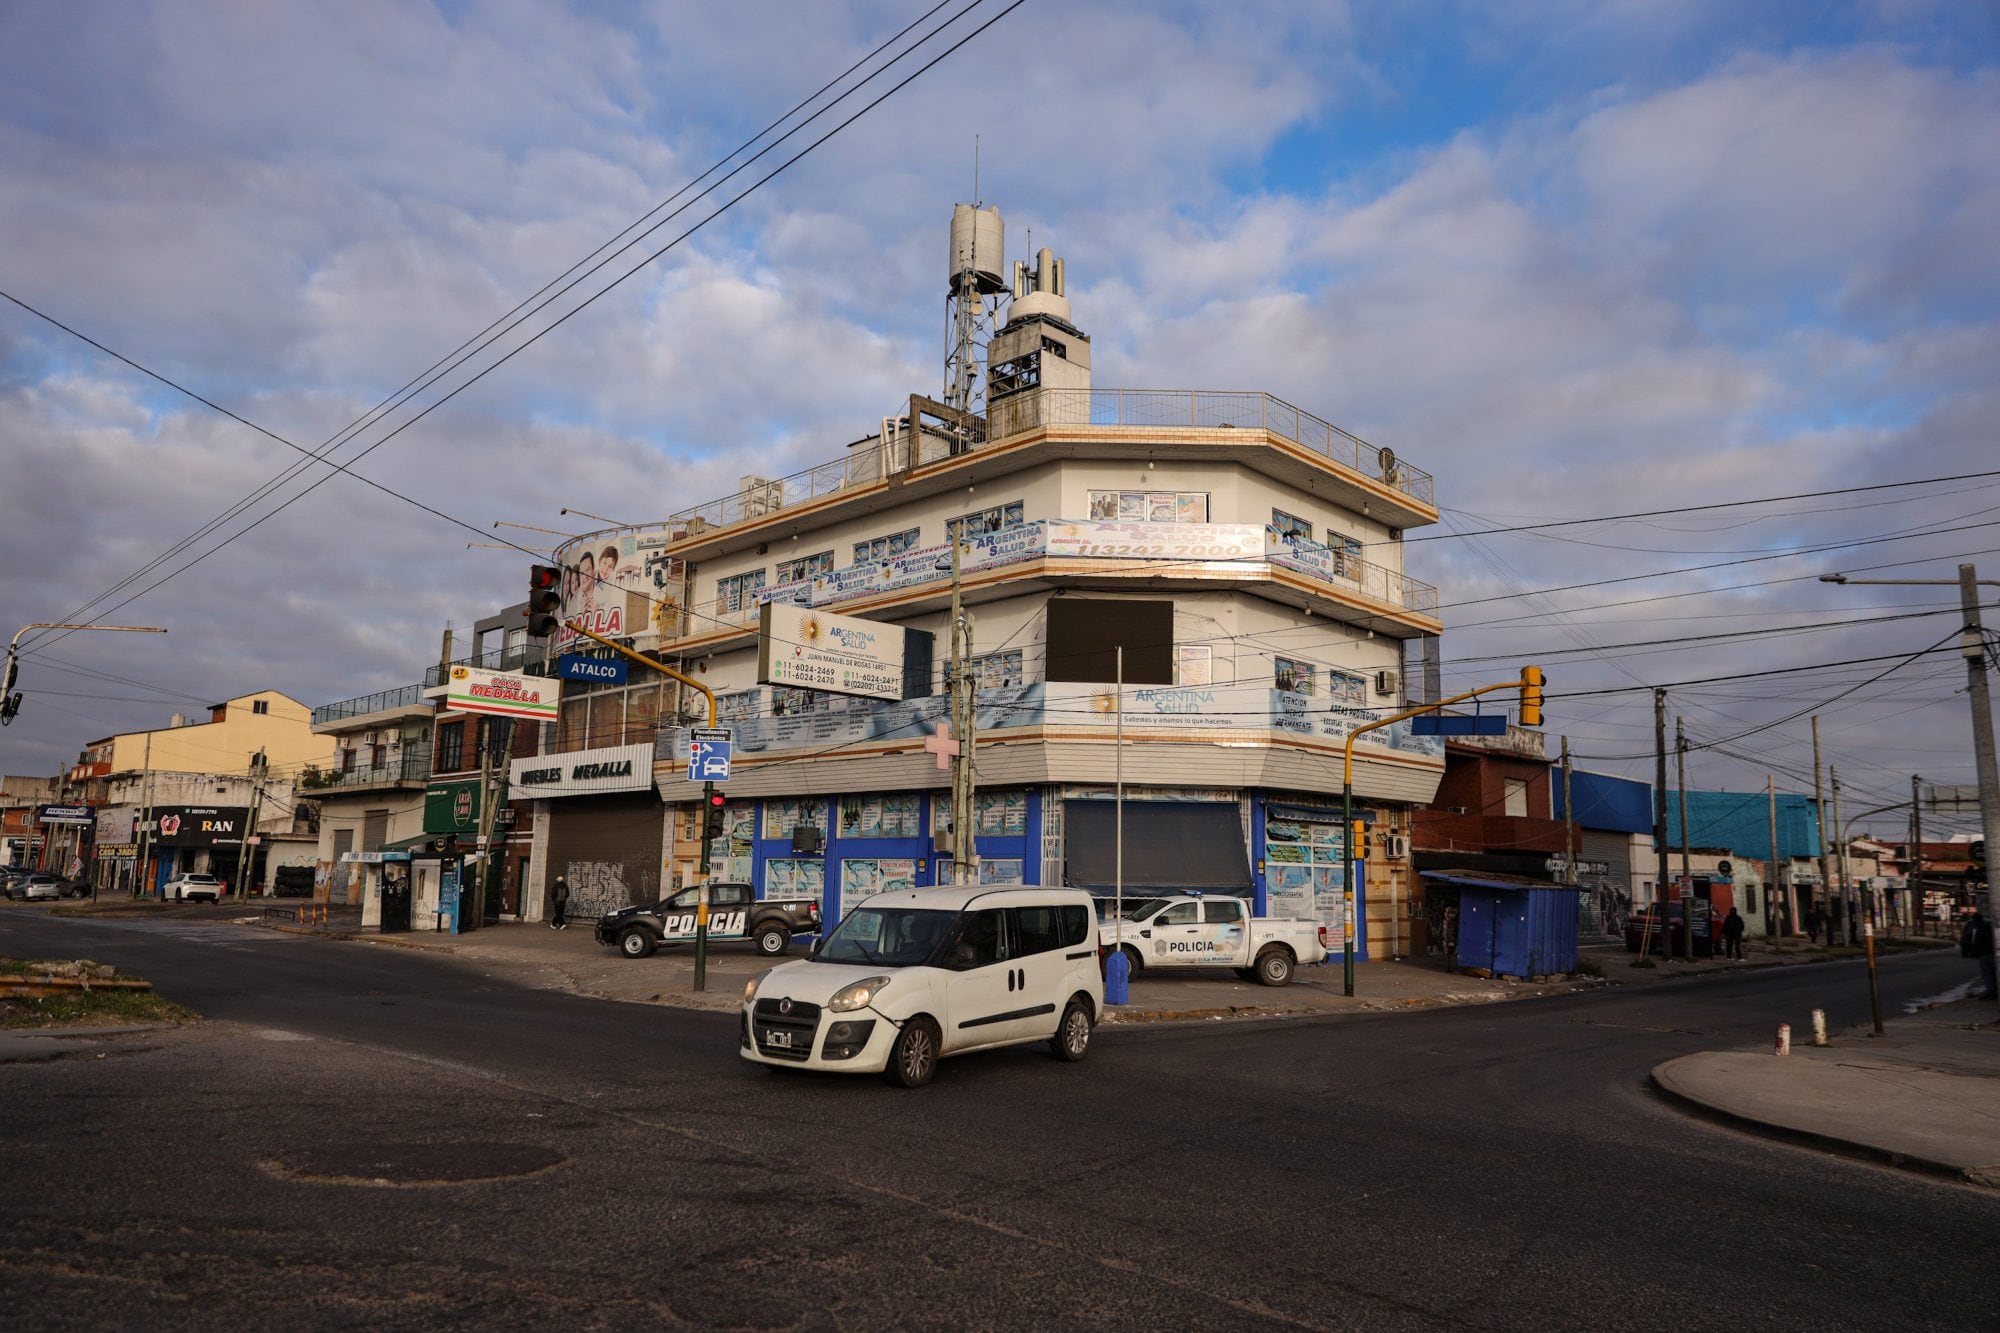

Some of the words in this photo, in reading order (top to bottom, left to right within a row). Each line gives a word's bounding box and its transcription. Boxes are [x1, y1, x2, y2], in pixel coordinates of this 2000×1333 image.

[977, 526, 1042, 549] ARGENTINA
[989, 541, 1026, 557] SALUD
[1175, 545, 1242, 556] 7000
[894, 554, 937, 569] ARGENTINA
[1293, 548, 1319, 566] SALUD
[827, 566, 878, 584] ARGENTINA
[903, 565, 927, 574] SALUD
[837, 579, 865, 591] SALUD
[830, 627, 875, 643] ARGENTINA
[841, 637, 866, 650] SALUD
[808, 653, 822, 661] JUAN
[823, 655, 845, 665] MANUEL
[854, 661, 871, 669] ROSAS
[454, 668, 465, 676] 47
[571, 662, 616, 677] ATALCO
[783, 661, 835, 676] 11-6024-2469
[491, 677, 522, 690] CASA
[783, 670, 835, 685] 11-6024-2470
[851, 679, 875, 691] (02202)
[470, 683, 540, 703] MEDALLA
[1136, 689, 1215, 703] ARGENTINA
[1155, 702, 1199, 713] SALUD
[1282, 696, 1307, 707] ATENCION
[1205, 717, 1233, 725] hacemos
[1348, 708, 1382, 721] PROTEGIDAS
[521, 767, 562, 785] MUEBLES
[572, 759, 632, 780] MEDALLA
[201, 821, 234, 831] RAN
[1170, 941, 1214, 952] POLICIA
